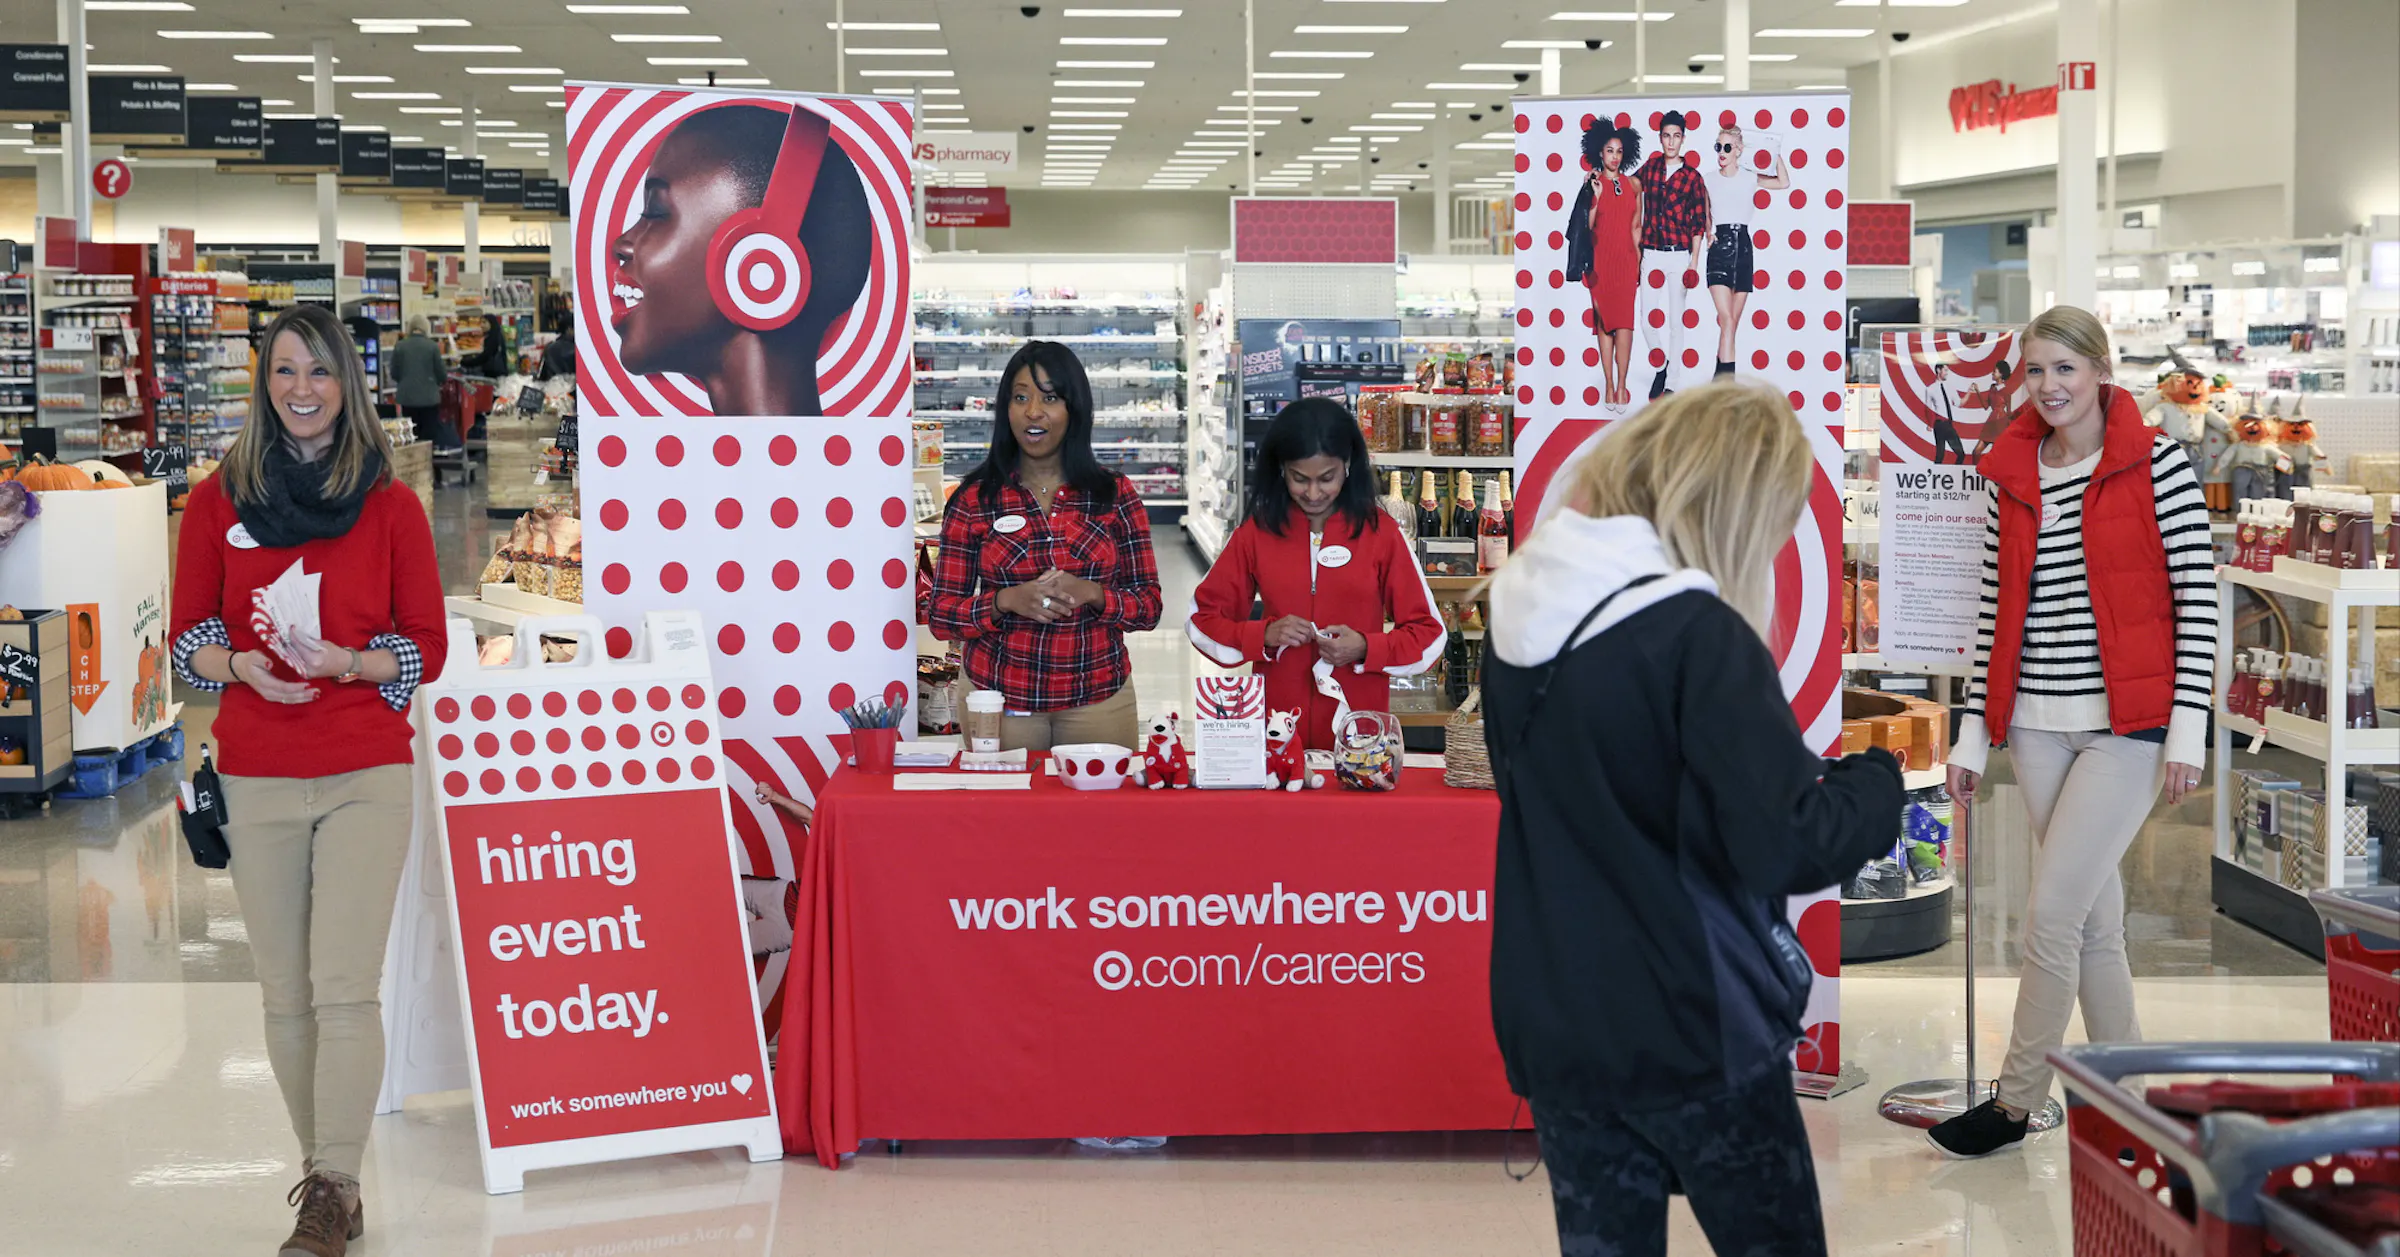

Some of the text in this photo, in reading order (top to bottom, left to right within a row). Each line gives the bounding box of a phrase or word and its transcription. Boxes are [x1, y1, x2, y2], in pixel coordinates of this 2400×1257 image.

[16, 51, 64, 60] Condiments
[13, 72, 64, 82] Canned Fruit
[133, 82, 180, 90] Rice & Beans
[145, 101, 151, 109] &
[937, 148, 1011, 164] pharmacy
[926, 195, 989, 205] Personal Care
[161, 280, 208, 292] Batteries
[1243, 348, 1282, 365] NSIDER
[1243, 362, 1284, 376] SECRETS
[1896, 491, 1971, 501] starting at $12/hr
[1896, 513, 1922, 521] come
[1925, 512, 1943, 523] join
[1946, 515, 1961, 523] our
[1910, 645, 1944, 653] somewhere
[3, 645, 38, 672] $2.99
[1203, 721, 1225, 729] we're
[477, 831, 636, 886] hiring
[948, 882, 1488, 933] work somewhere you
[489, 905, 646, 962] event
[496, 984, 669, 1039] today.
[511, 1081, 727, 1119] work somewhere you
